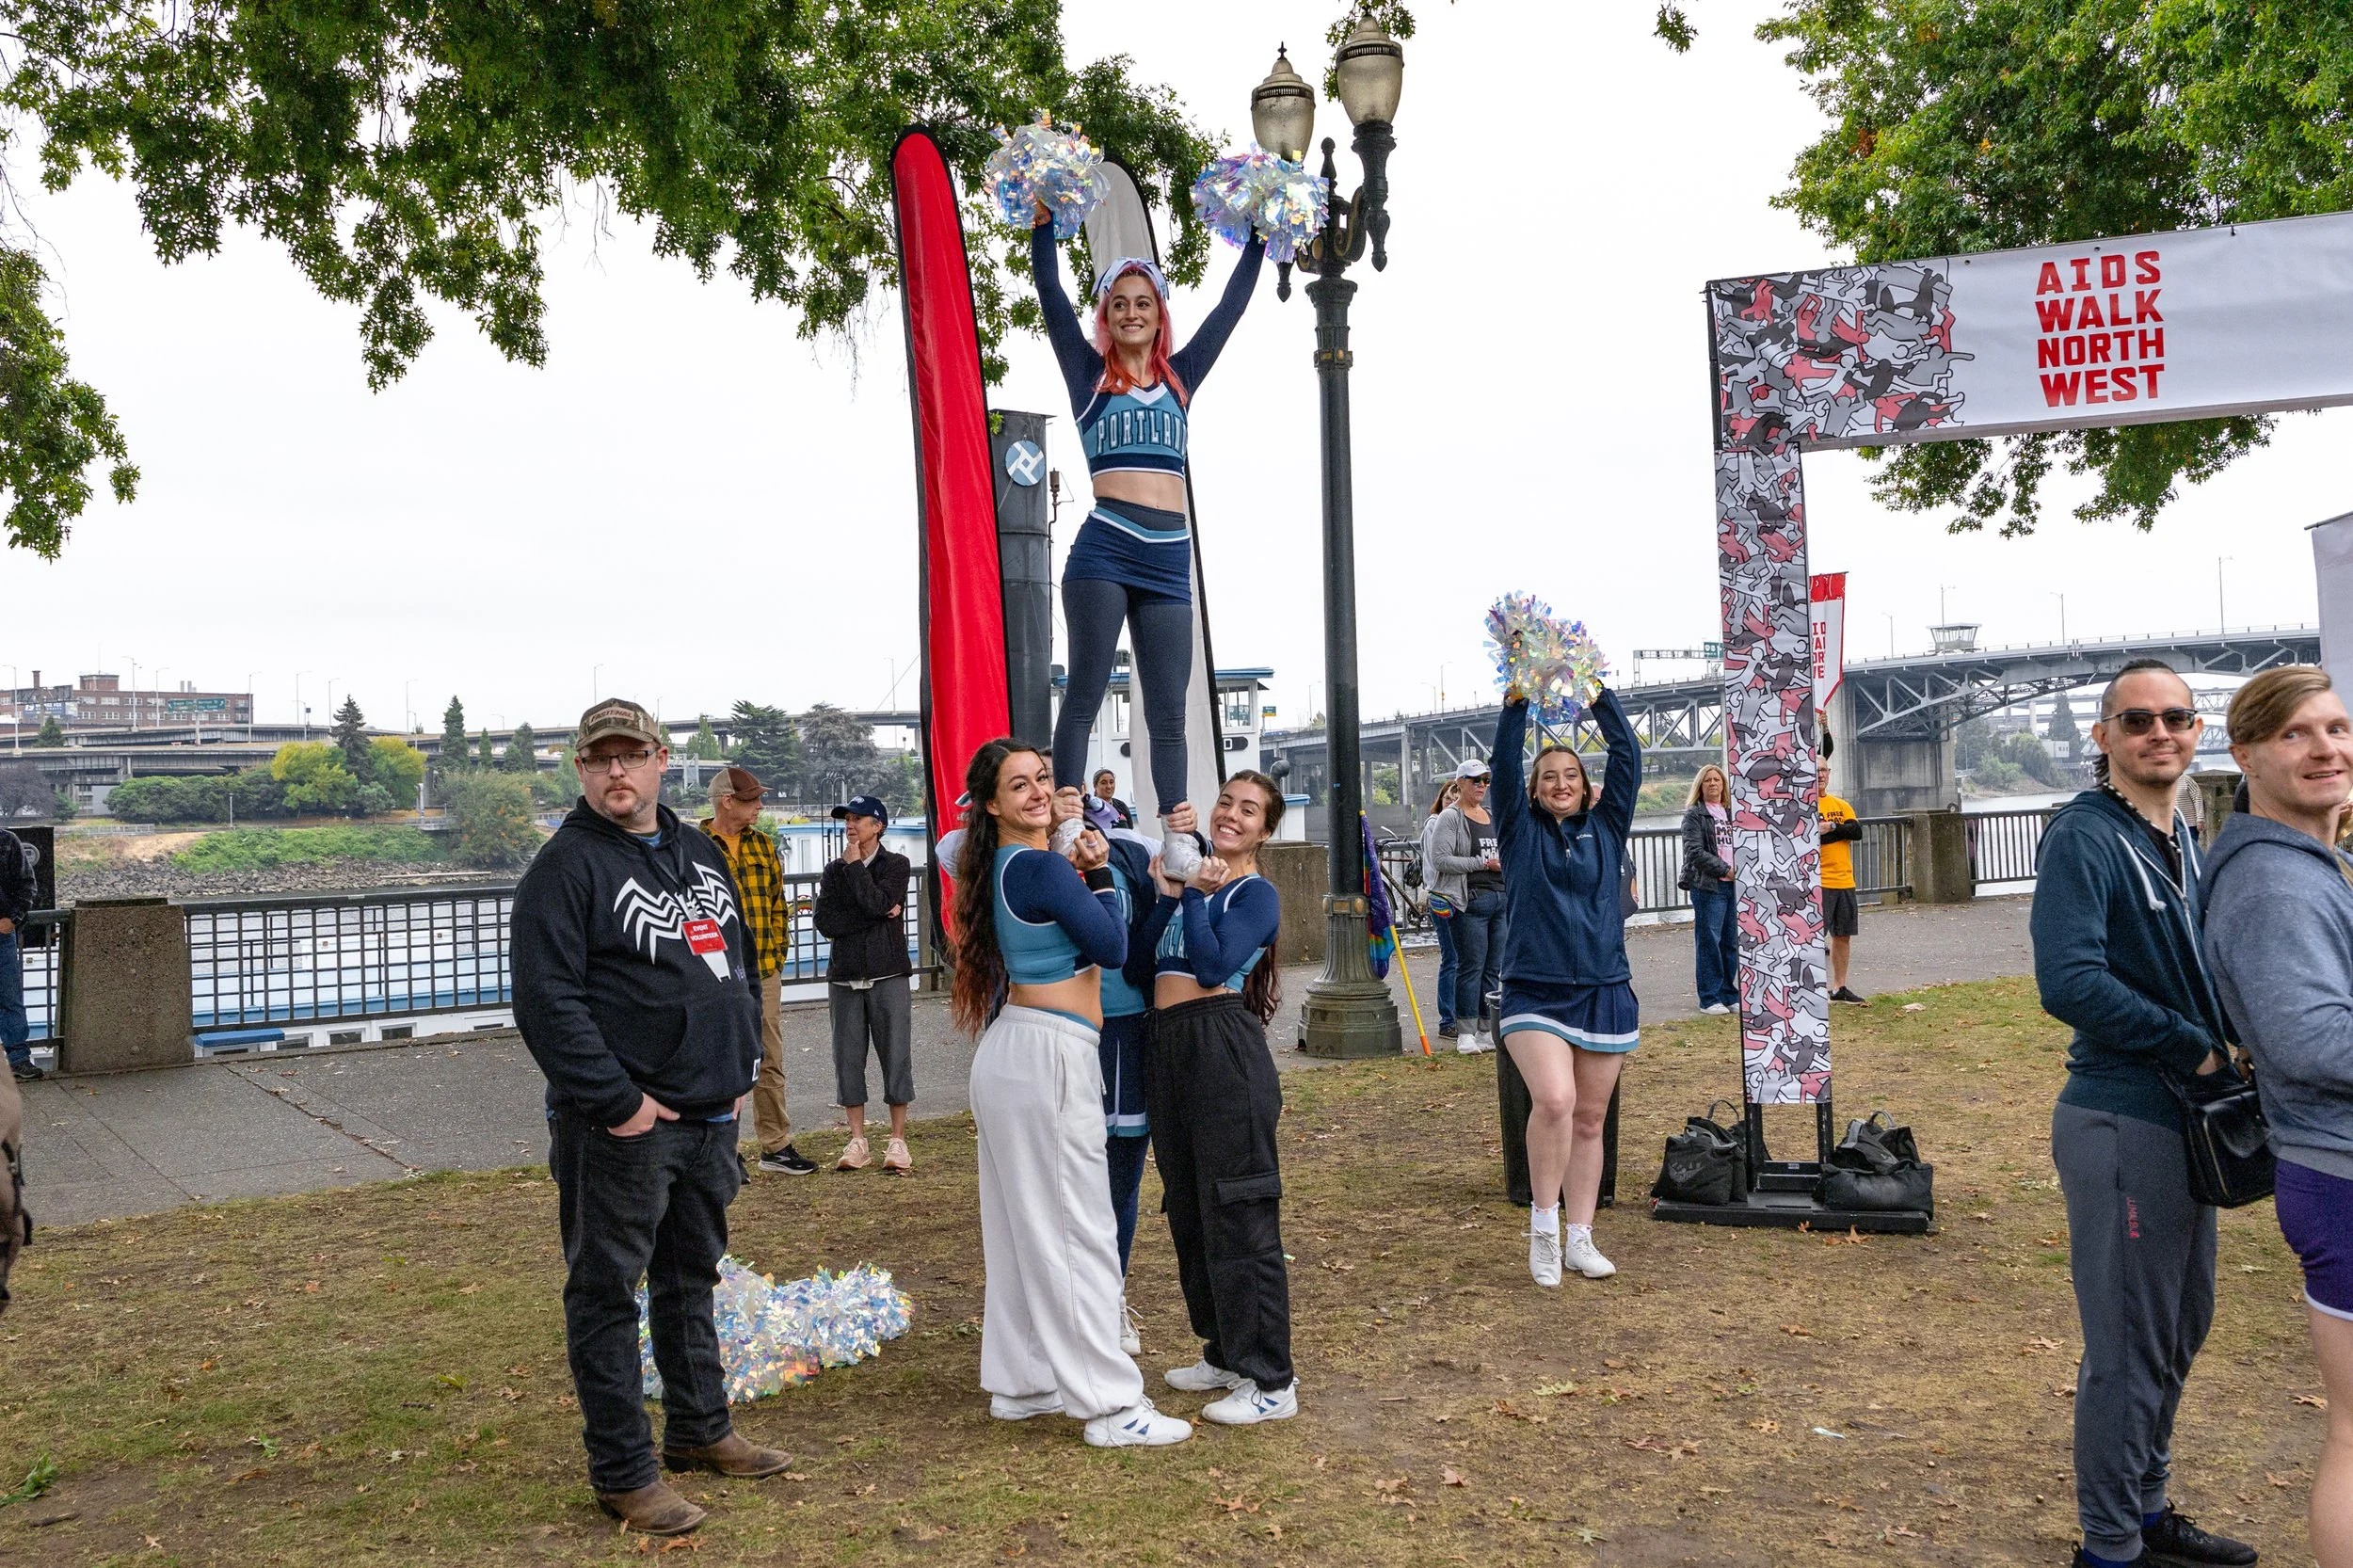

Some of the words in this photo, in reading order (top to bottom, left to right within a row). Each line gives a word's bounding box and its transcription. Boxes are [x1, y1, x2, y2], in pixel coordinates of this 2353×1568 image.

[2036, 250, 2161, 296] AIDS
[2035, 288, 2164, 333] WALK
[2037, 328, 2165, 369] NORTH
[2040, 363, 2165, 408] WEST
[1096, 408, 1187, 457] PORTLAN
[1812, 621, 1826, 635] ID
[1827, 810, 1844, 820] FREE
[1479, 838, 1498, 847] FRE
[1718, 837, 1732, 845] HU
[692, 924, 709, 933] EVENT
[690, 932, 719, 941] VOLUNTEER
